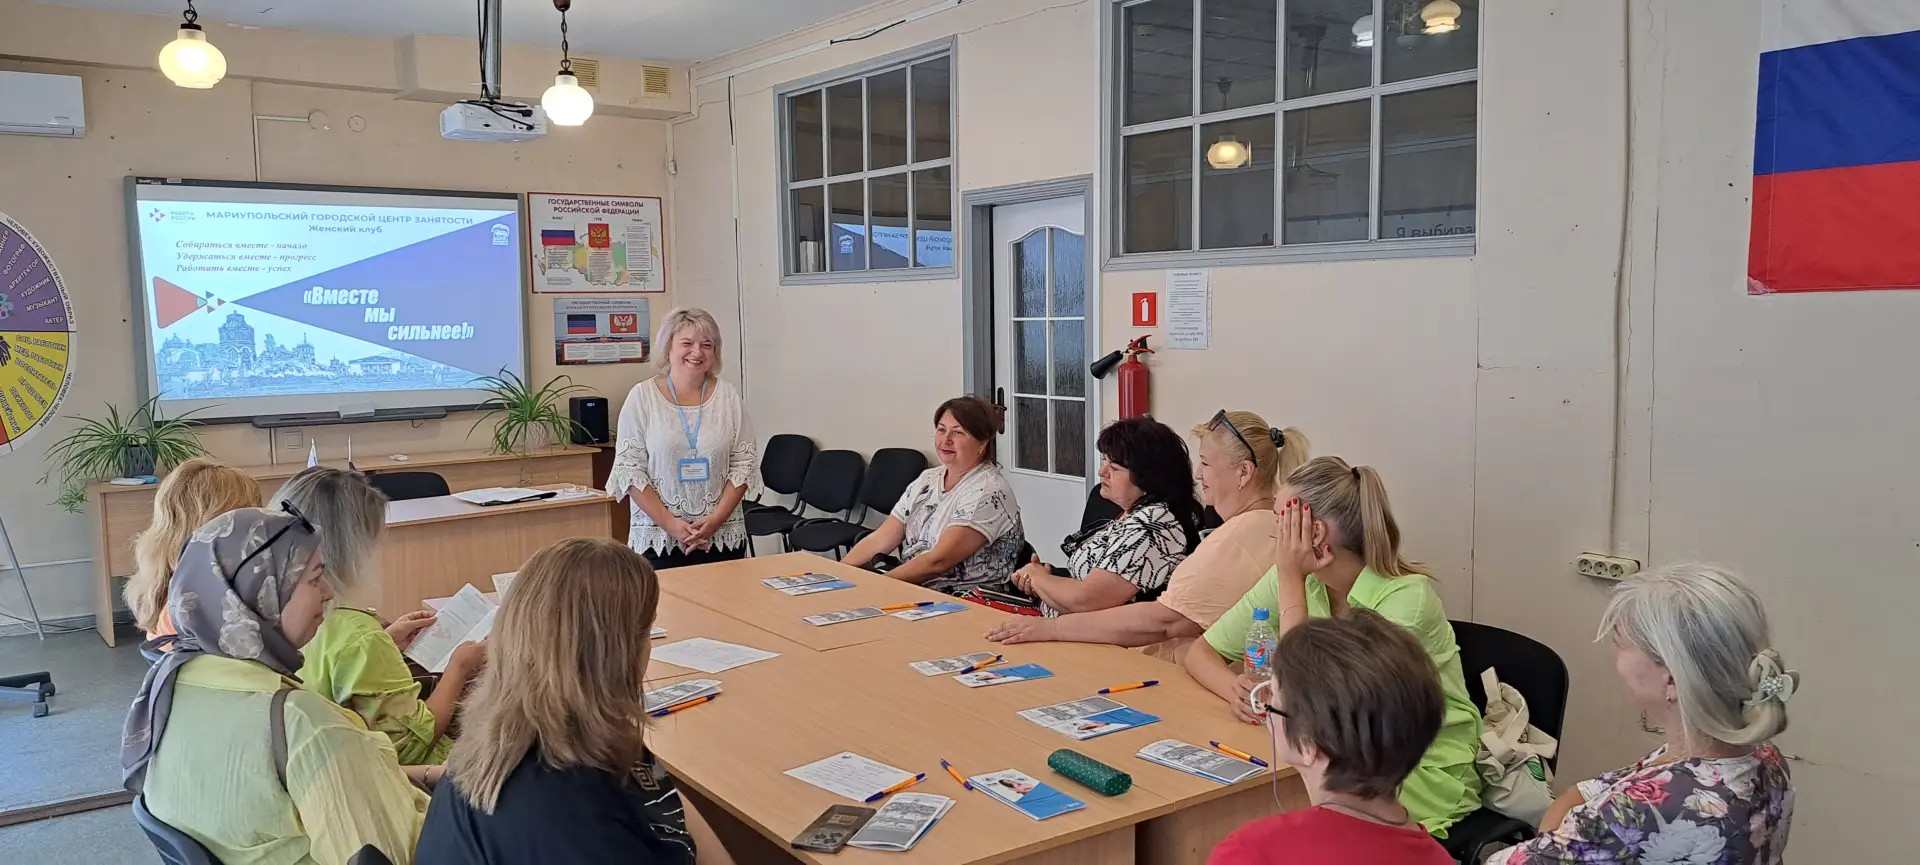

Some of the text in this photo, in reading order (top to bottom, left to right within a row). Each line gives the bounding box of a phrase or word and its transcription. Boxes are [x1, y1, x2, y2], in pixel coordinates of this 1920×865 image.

[548, 198, 644, 208] ГОСУДАРСТВЕННЫЕ СИМВОЛЫ
[553, 206, 640, 216] РОССИЙСКОЙ ФЕДЕРАЦИИ
[206, 211, 474, 225] МАРИУПОЛЬСКИЙ ГОРОДСКОЙ ЦЕНТР ЗАНЯТОСТИ
[308, 224, 383, 235] Женский клуб
[175, 240, 233, 250] Собираться
[3, 243, 26, 275] ФОТОГРАФ
[176, 252, 236, 262] Удержаться
[238, 253, 272, 261] вместе
[279, 254, 317, 263] прогресс
[6, 217, 75, 324] ЧЕЛОВЕК-ХУДОЖЕСТВЕННЫЙ ОБРАЗ
[8, 258, 39, 290] АРХИТЕКТОР
[176, 264, 225, 272] Работать
[266, 266, 292, 274] успех
[20, 276, 51, 299] ХУДОЖНИК
[303, 286, 380, 305] «Вместе
[26, 296, 59, 312] МУЗЫКАНТ
[44, 316, 64, 325] АКТЕР
[364, 307, 396, 323] мы
[387, 322, 475, 341] сильнее!»
[33, 338, 66, 351] РАБОТНИК
[14, 344, 63, 372] МЕД. РАБОТНИК
[15, 357, 57, 391] ВОСПИТАТЕЛЬ
[18, 376, 48, 409] ПРОДАВЕЦ
[39, 372, 73, 428] ЧЕЛОВЕК-ЧЕЛОВЕК
[9, 386, 35, 421] ПСИХОЛОГ
